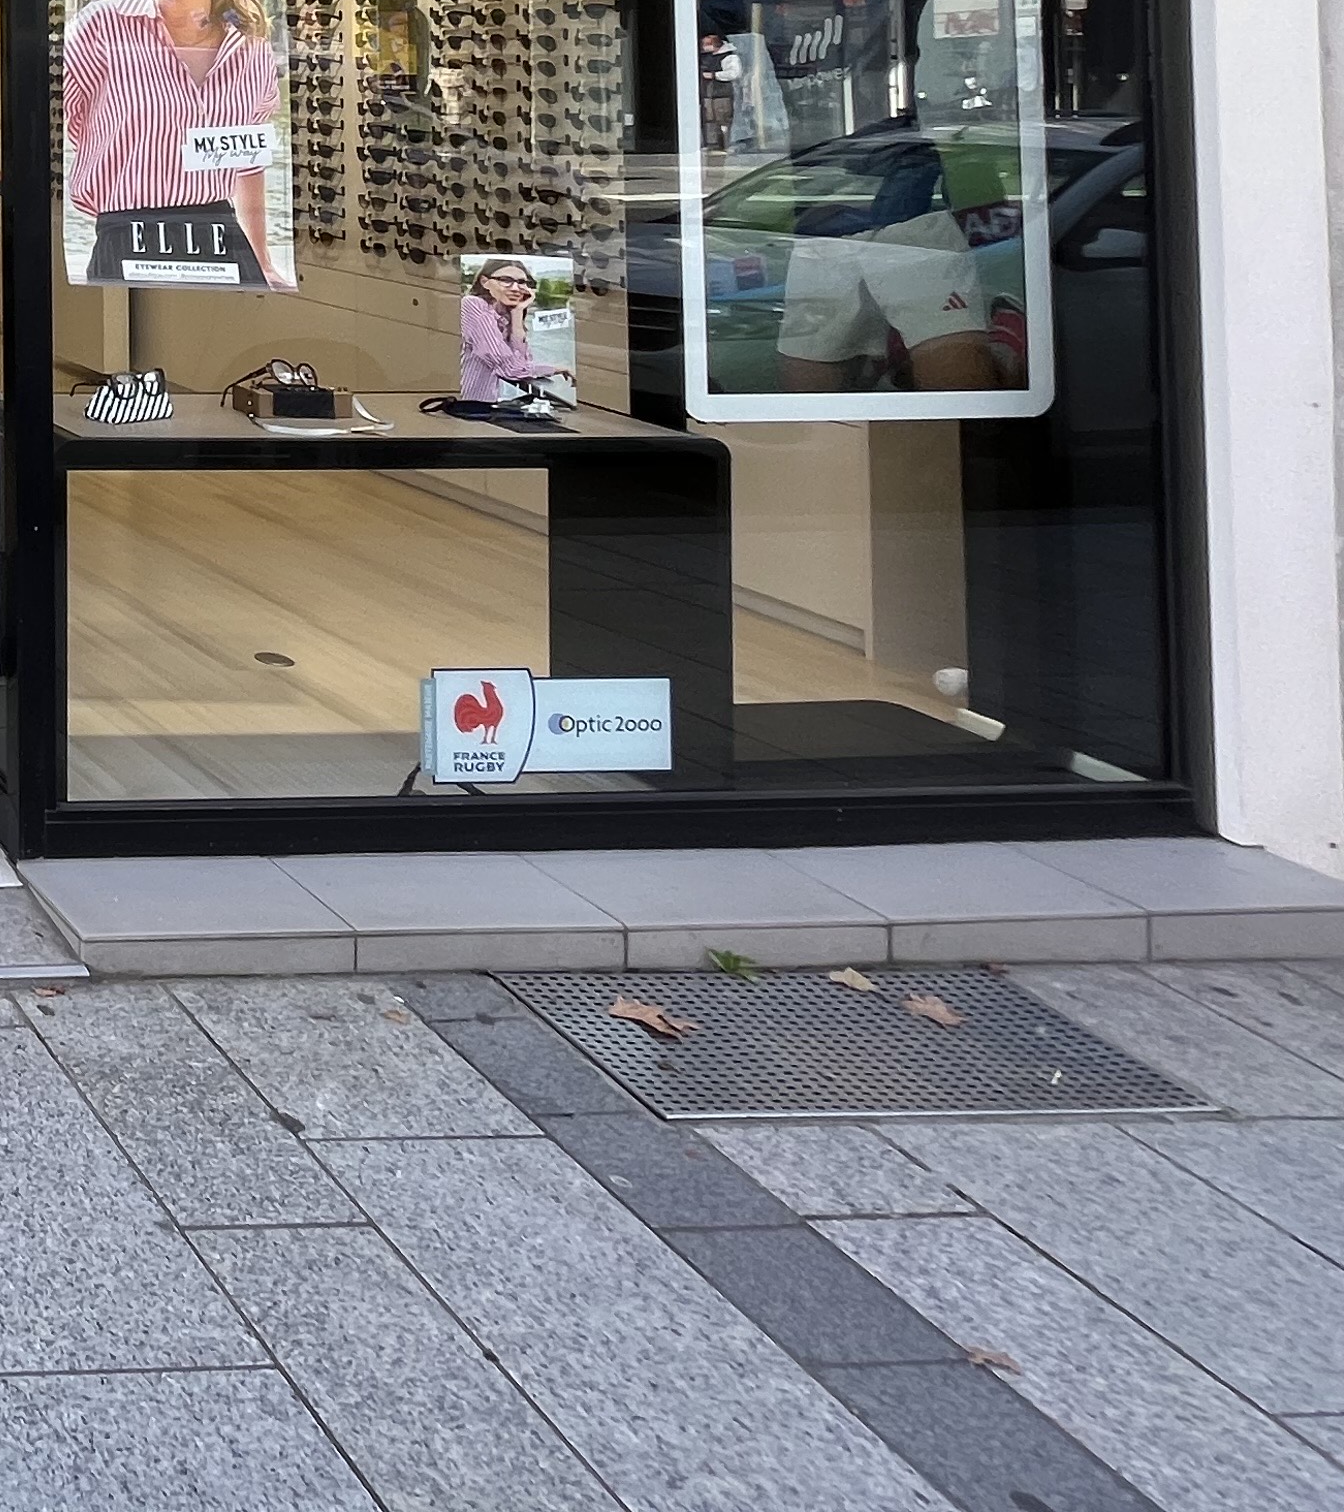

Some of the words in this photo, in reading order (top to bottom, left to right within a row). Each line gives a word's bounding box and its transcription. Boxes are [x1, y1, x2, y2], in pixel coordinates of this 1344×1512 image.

[194, 137, 217, 153] MY
[220, 133, 268, 151] STYLE
[229, 148, 262, 164] way
[130, 220, 227, 255] ELLE
[134, 263, 173, 271] EYEWEAR
[175, 264, 226, 272] COLLECTION
[558, 714, 613, 738] Optic
[615, 716, 662, 732] 2000
[453, 751, 506, 762] FRANCE
[454, 761, 506, 773] RUGBY
